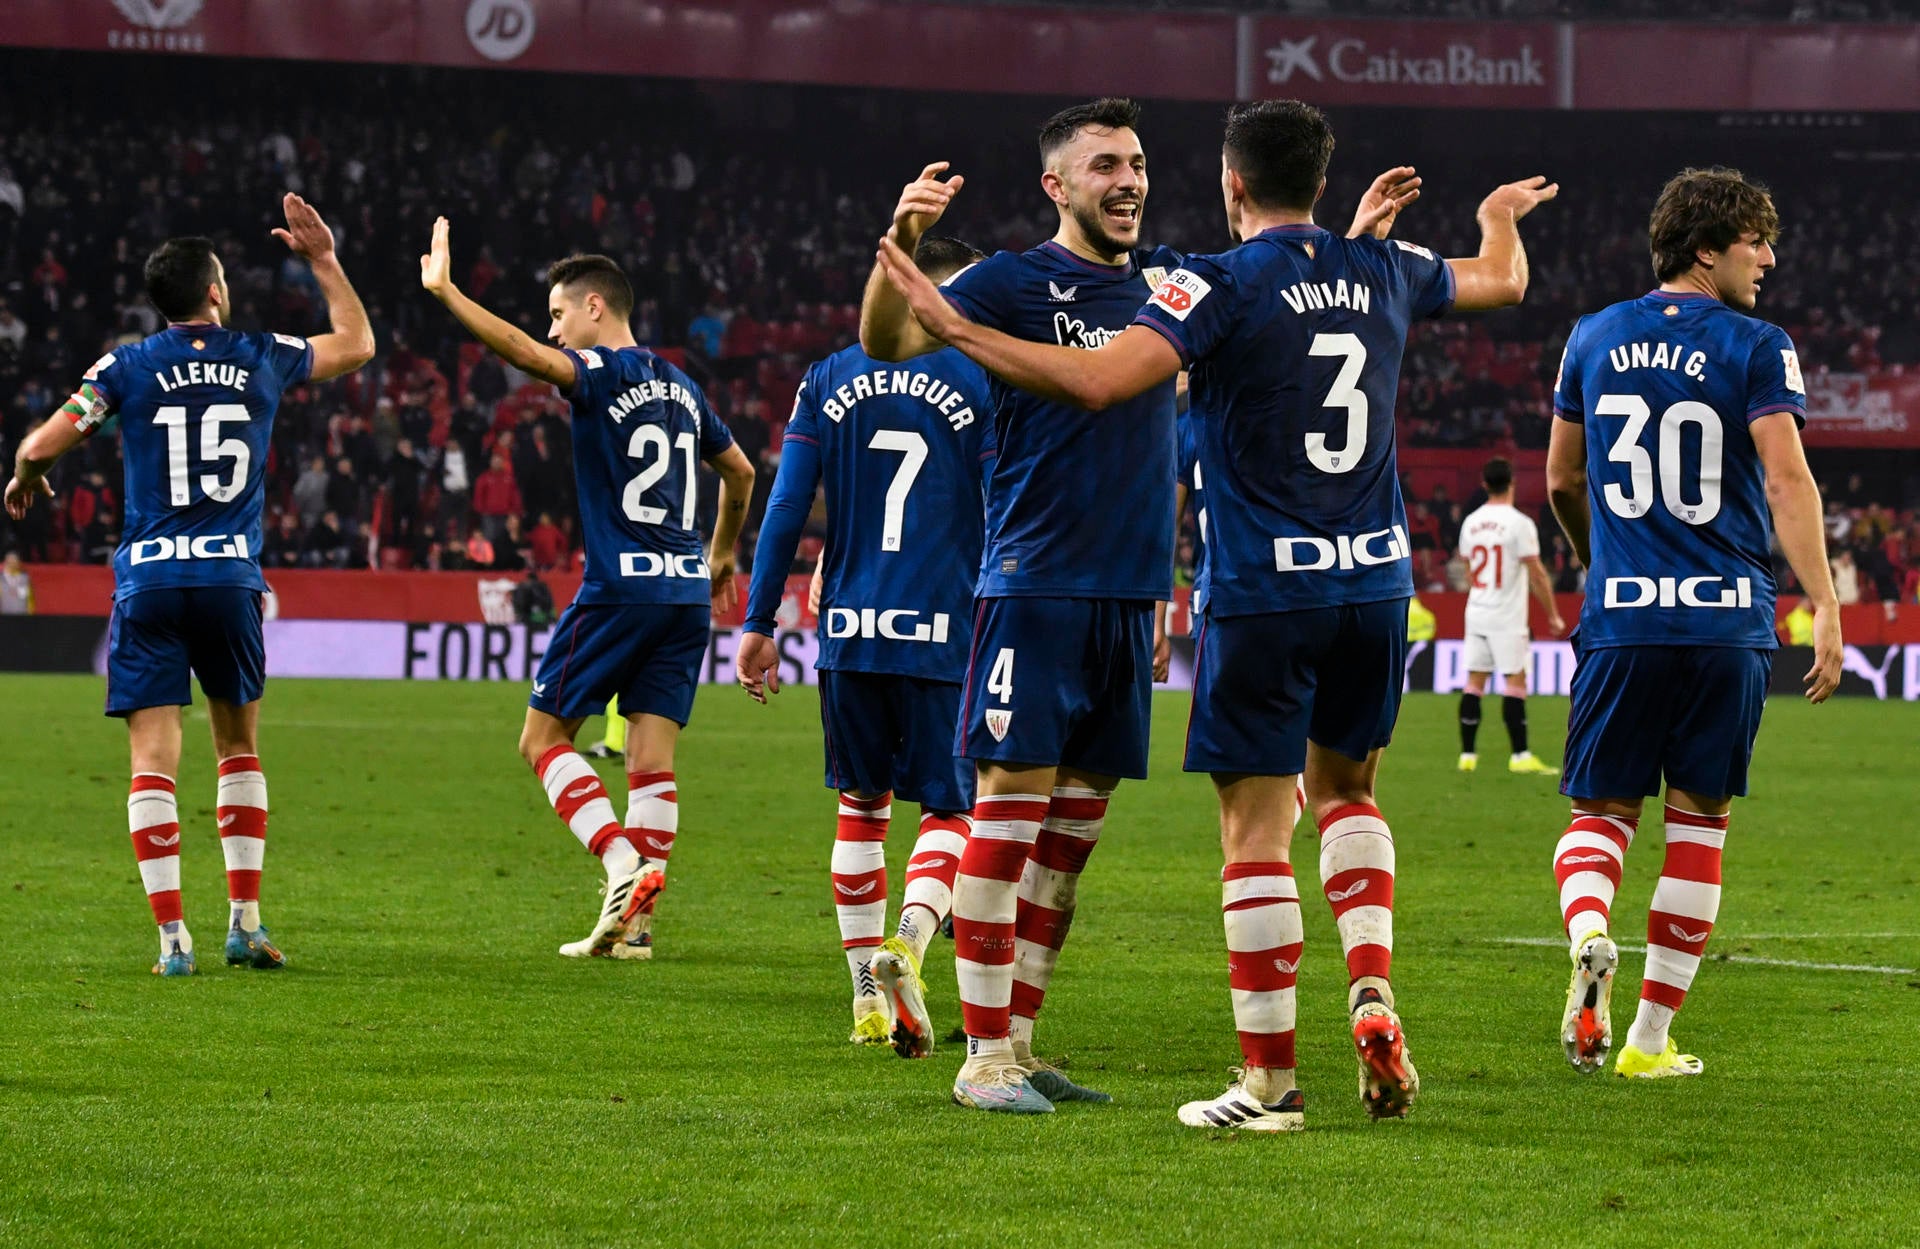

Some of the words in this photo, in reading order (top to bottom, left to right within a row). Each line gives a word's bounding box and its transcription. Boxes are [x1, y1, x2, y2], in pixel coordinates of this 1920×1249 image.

[476, 5, 525, 40] JD
[1329, 39, 1544, 86] CaixaBank
[1280, 279, 1370, 315] VIVIAN
[155, 361, 250, 392] I.LEKUE
[1609, 342, 1683, 373] UNAI
[1684, 350, 1707, 382] G.
[822, 370, 975, 432] BERENGUER
[1304, 333, 1369, 474] 3
[152, 404, 252, 507] 15
[621, 423, 697, 531] 21
[1594, 394, 1724, 526] 30
[868, 429, 929, 552] 7
[130, 534, 249, 566] DIGI
[1273, 524, 1410, 572] DIGI
[1471, 544, 1504, 590] 21
[1604, 576, 1752, 609] DIGI
[827, 608, 950, 643] DIGI
[987, 647, 1015, 704] 4
